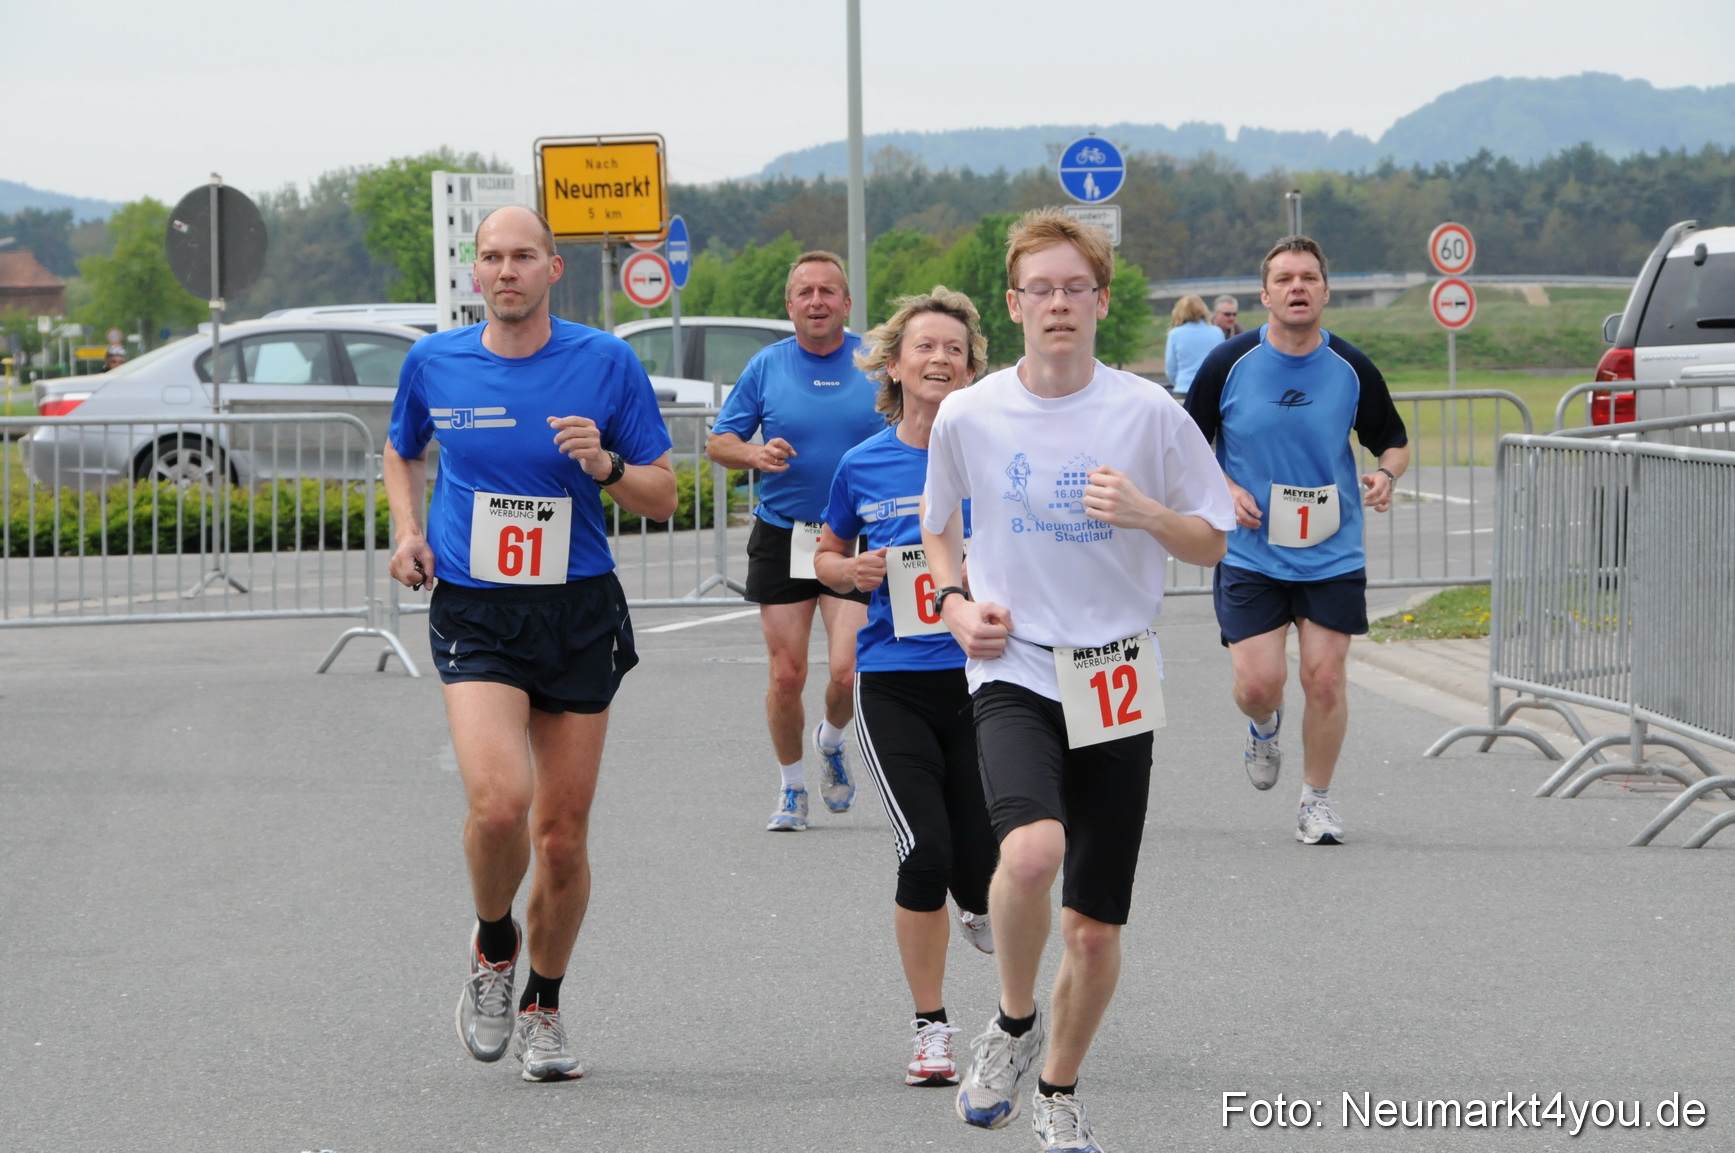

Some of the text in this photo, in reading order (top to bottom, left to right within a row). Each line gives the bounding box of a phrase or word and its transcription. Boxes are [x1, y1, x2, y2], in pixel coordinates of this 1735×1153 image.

[585, 158, 619, 170] Nach
[554, 175, 651, 199] Neumarkt
[588, 207, 622, 219] 5 km
[1441, 239, 1465, 260] 60
[1282, 496, 1316, 504] WERBUNG
[1283, 488, 1316, 498] MEYER
[489, 498, 534, 511] MEYER
[489, 508, 535, 519] WERBUNG
[1011, 517, 1031, 533] 8.
[1297, 505, 1309, 540] 1
[1055, 529, 1113, 543] Stadtlauf
[497, 525, 543, 577] 61
[914, 573, 943, 625] 6
[1073, 642, 1120, 661] MEYER
[1074, 653, 1122, 670] WERBUNG
[1089, 664, 1142, 728] 12
